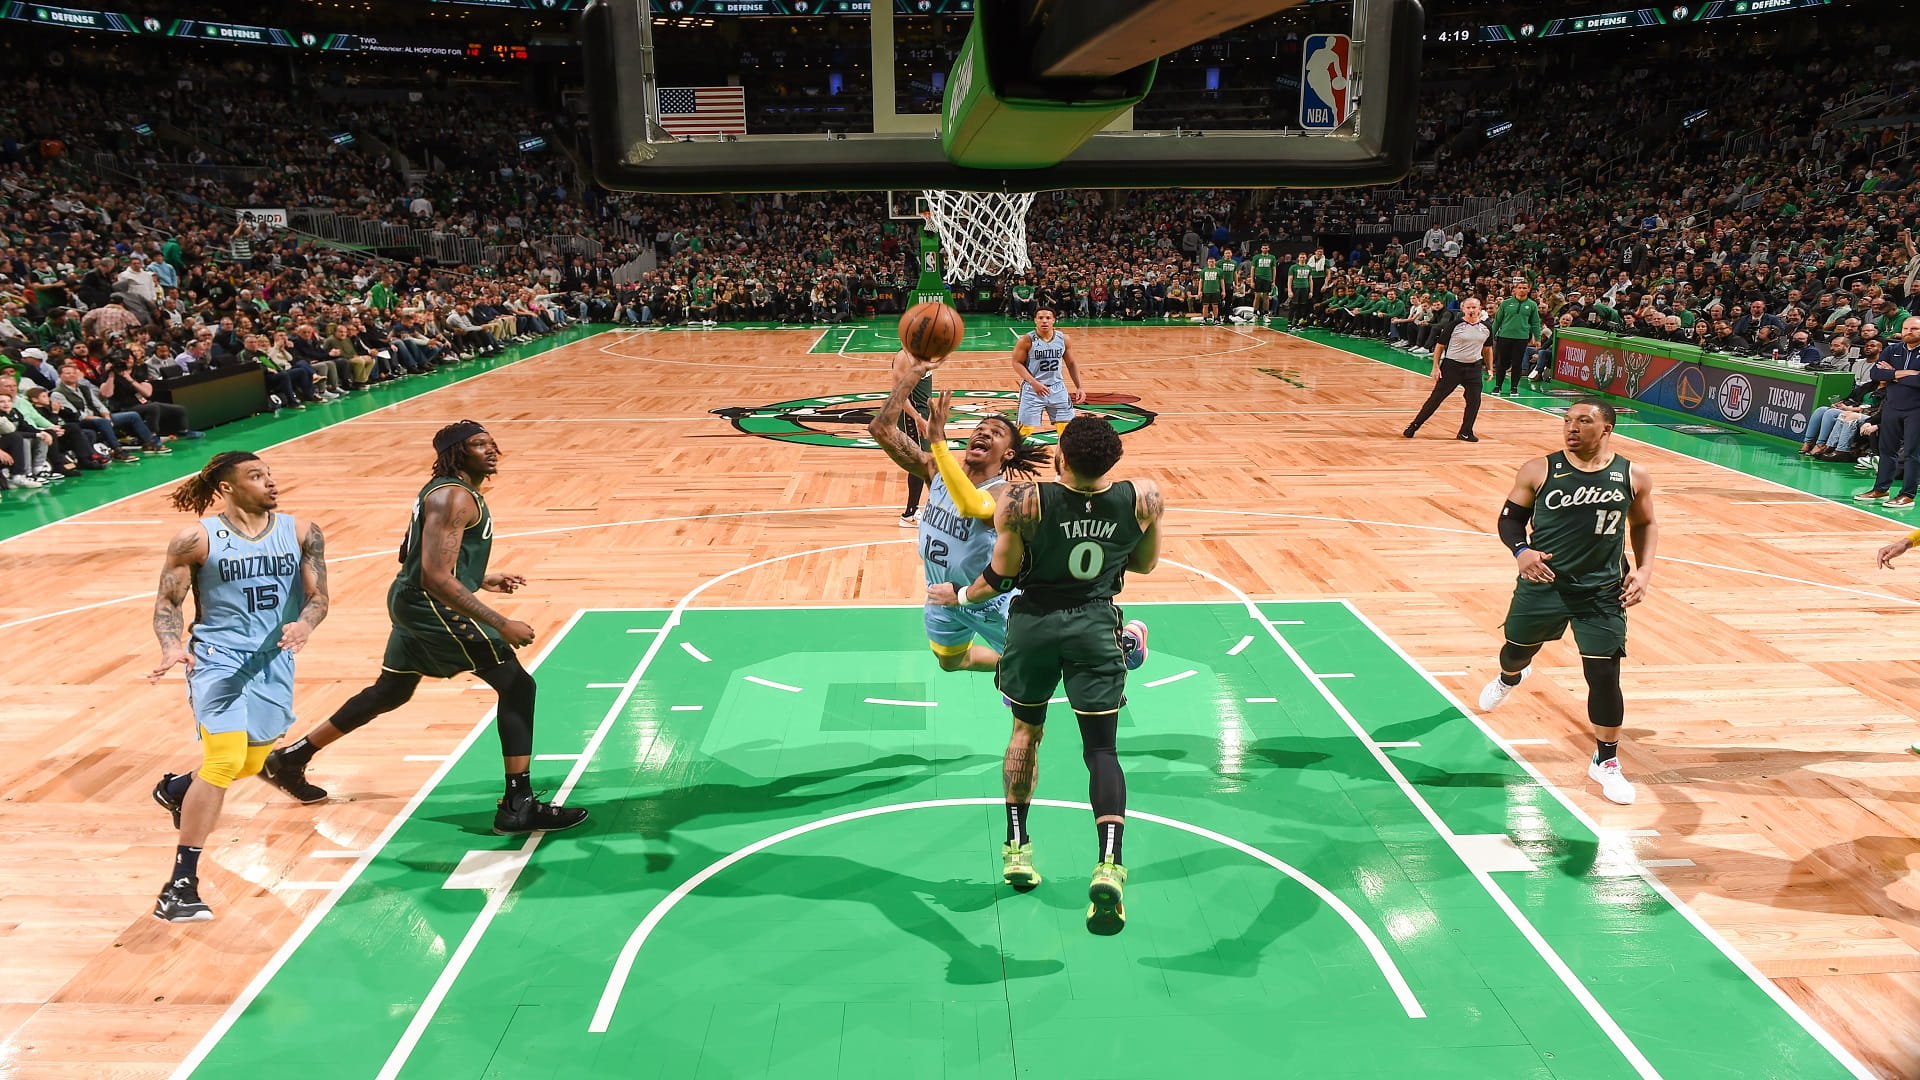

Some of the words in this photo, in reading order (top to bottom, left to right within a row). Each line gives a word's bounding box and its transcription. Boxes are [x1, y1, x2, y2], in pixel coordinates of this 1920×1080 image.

[727, 2, 764, 12] DEFENSE
[852, 2, 871, 10] DEFE
[51, 11, 95, 25] DEFENSE
[1587, 16, 1627, 28] DEFENSE
[220, 27, 261, 40] DEFENSE
[1438, 30, 1470, 42] 4:19
[414, 47, 447, 55] HORFORD
[1306, 108, 1329, 124] NBA
[1565, 346, 1587, 364] TUESDAY
[1040, 360, 1060, 372] 22
[1708, 385, 1717, 400] VS
[1767, 386, 1806, 412] TUESDAY
[1758, 405, 1779, 427] 10PM
[1779, 412, 1789, 429] ET
[1544, 485, 1626, 510] Celtics
[922, 502, 974, 542] GRIZZLIES
[1059, 519, 1118, 540] TATUM
[1593, 508, 1622, 535] 12
[924, 533, 949, 569] 12
[1068, 540, 1105, 580] 0
[218, 552, 295, 583] GRIZZLIES
[242, 583, 280, 614] 15
